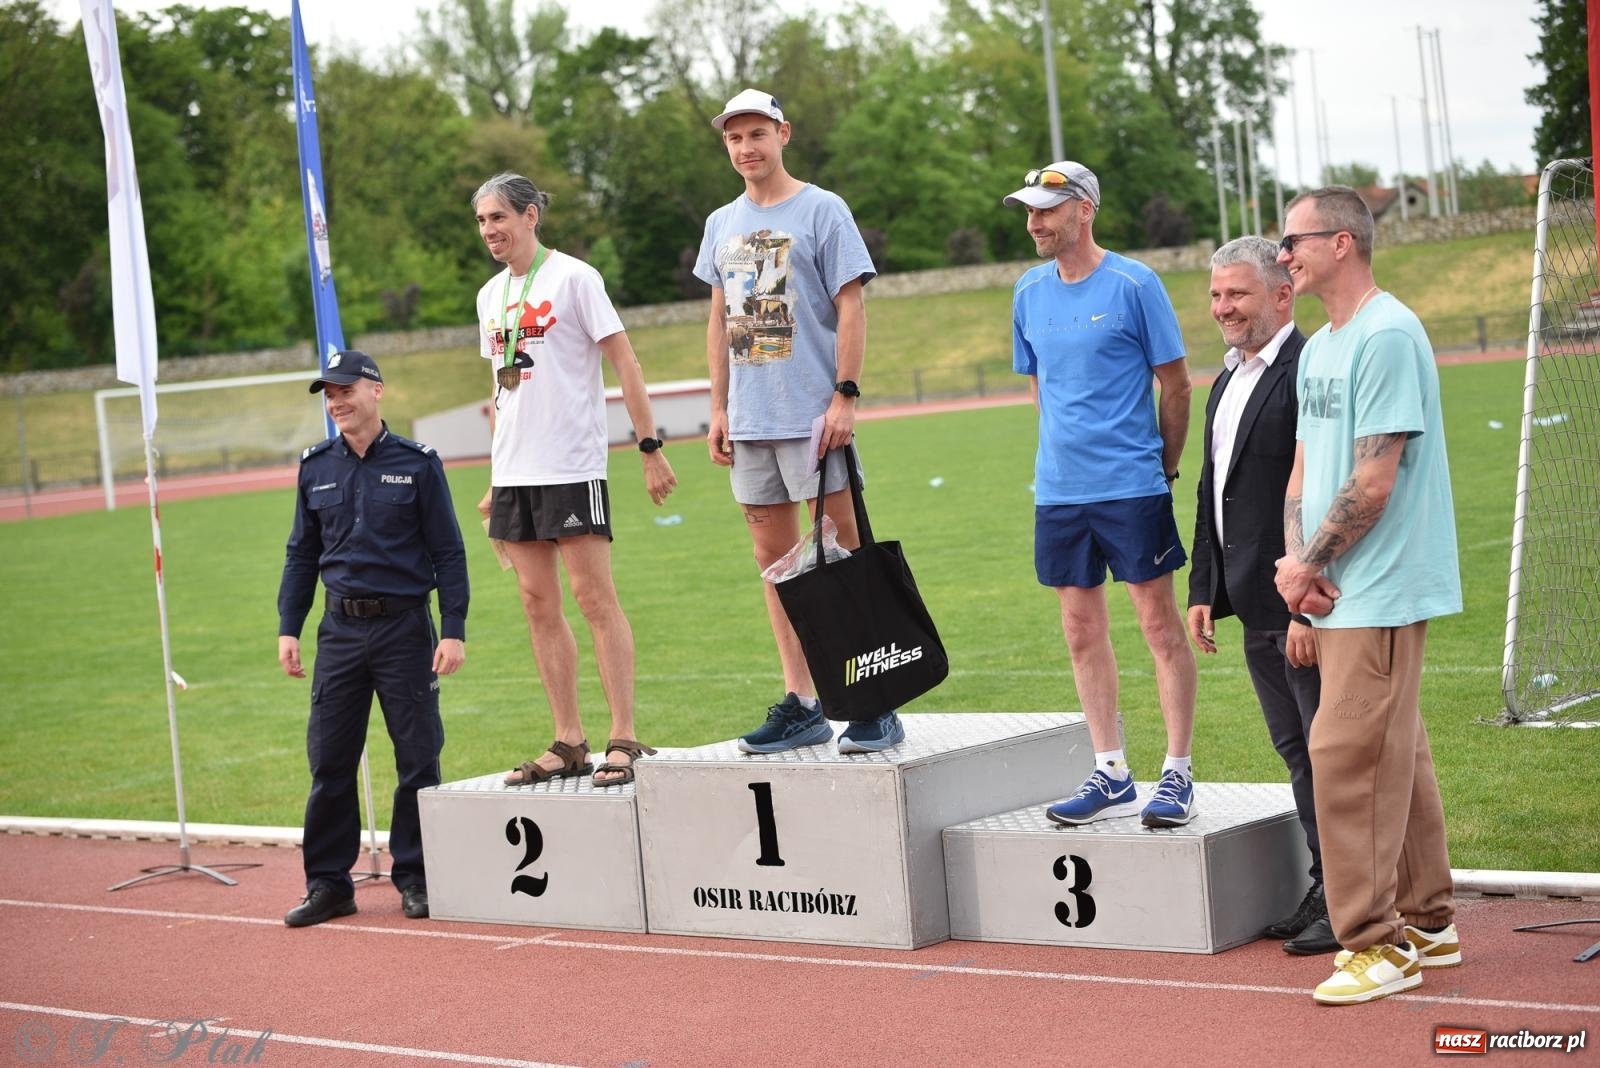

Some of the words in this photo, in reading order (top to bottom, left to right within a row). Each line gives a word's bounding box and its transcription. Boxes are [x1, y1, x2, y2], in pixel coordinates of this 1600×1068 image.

[381, 474, 412, 484] POLICJA
[856, 646, 923, 682] FITNESS
[857, 642, 902, 667] WELL
[748, 782, 785, 866] 1
[505, 816, 548, 897] 2
[693, 886, 743, 910] OSIR
[748, 888, 858, 916] RACIBÓRZ
[1053, 854, 1096, 928] 3
